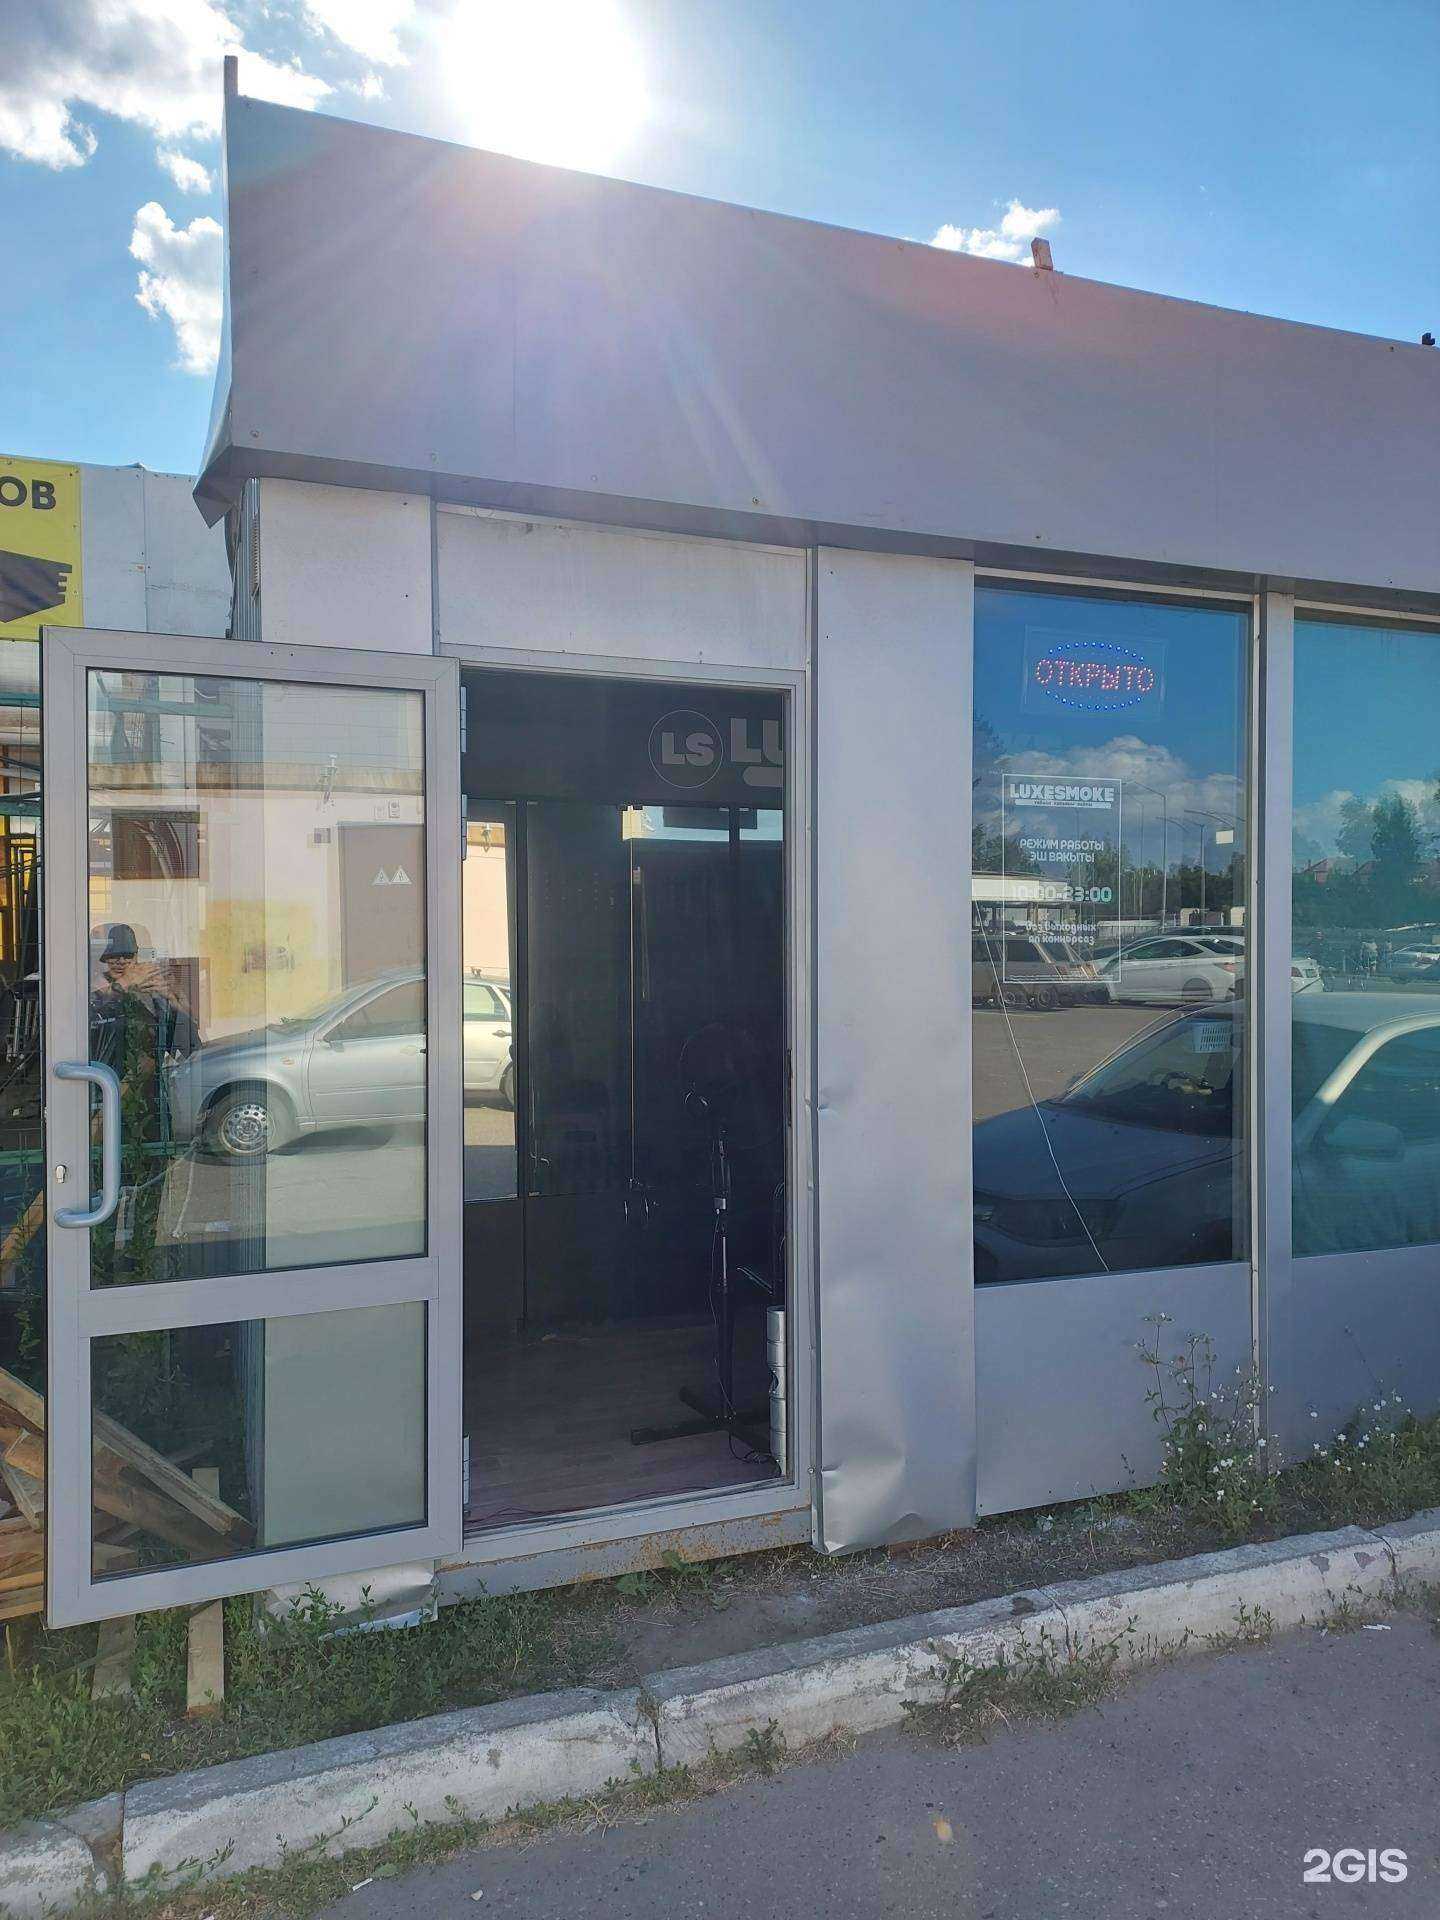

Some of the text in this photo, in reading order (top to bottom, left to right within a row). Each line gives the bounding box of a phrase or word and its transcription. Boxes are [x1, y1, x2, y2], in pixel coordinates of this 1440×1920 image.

[1035, 657, 1156, 693] ОТКРЫТО
[661, 732, 715, 767] LS
[1009, 783, 1115, 802] LUXESMOKE
[1019, 838, 1104, 851] РЕЖИМ РАБОТЫ
[1030, 851, 1095, 863] ЭШ ВАКЫТЫ
